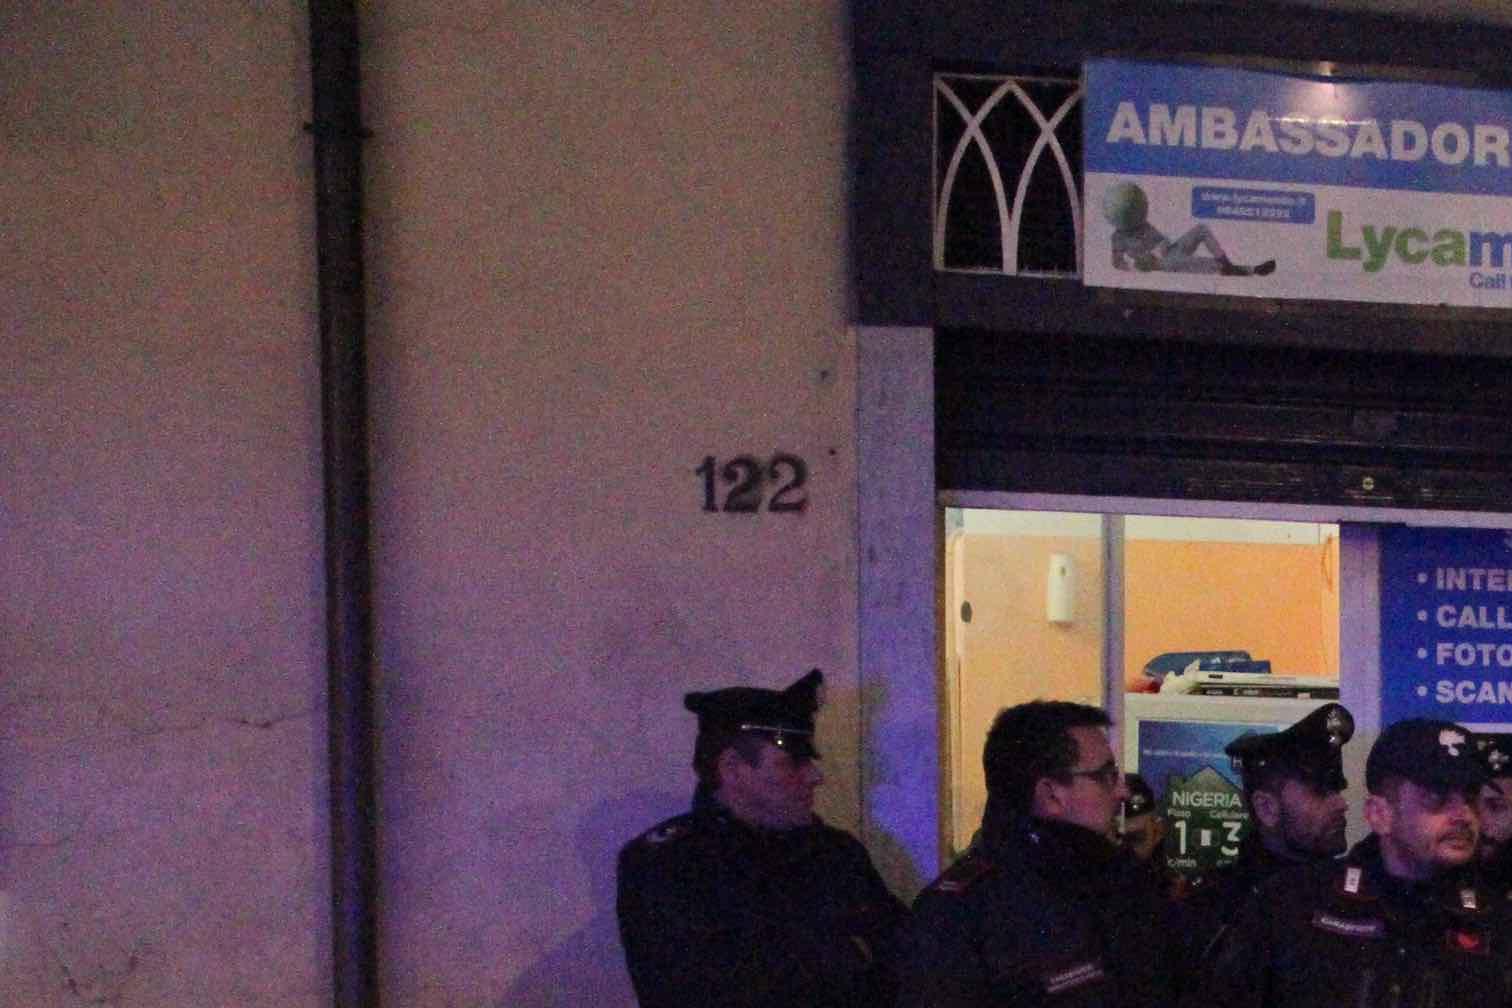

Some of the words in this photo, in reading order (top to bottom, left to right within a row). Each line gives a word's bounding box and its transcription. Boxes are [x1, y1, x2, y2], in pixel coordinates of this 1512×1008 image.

[1105, 101, 1511, 168] AMBASSADOR
[1469, 272, 1505, 289] Call
[695, 454, 808, 513] 122
[1172, 791, 1242, 808] NIGERIA
[1174, 820, 1187, 855] 1
[1220, 821, 1242, 856] 3
